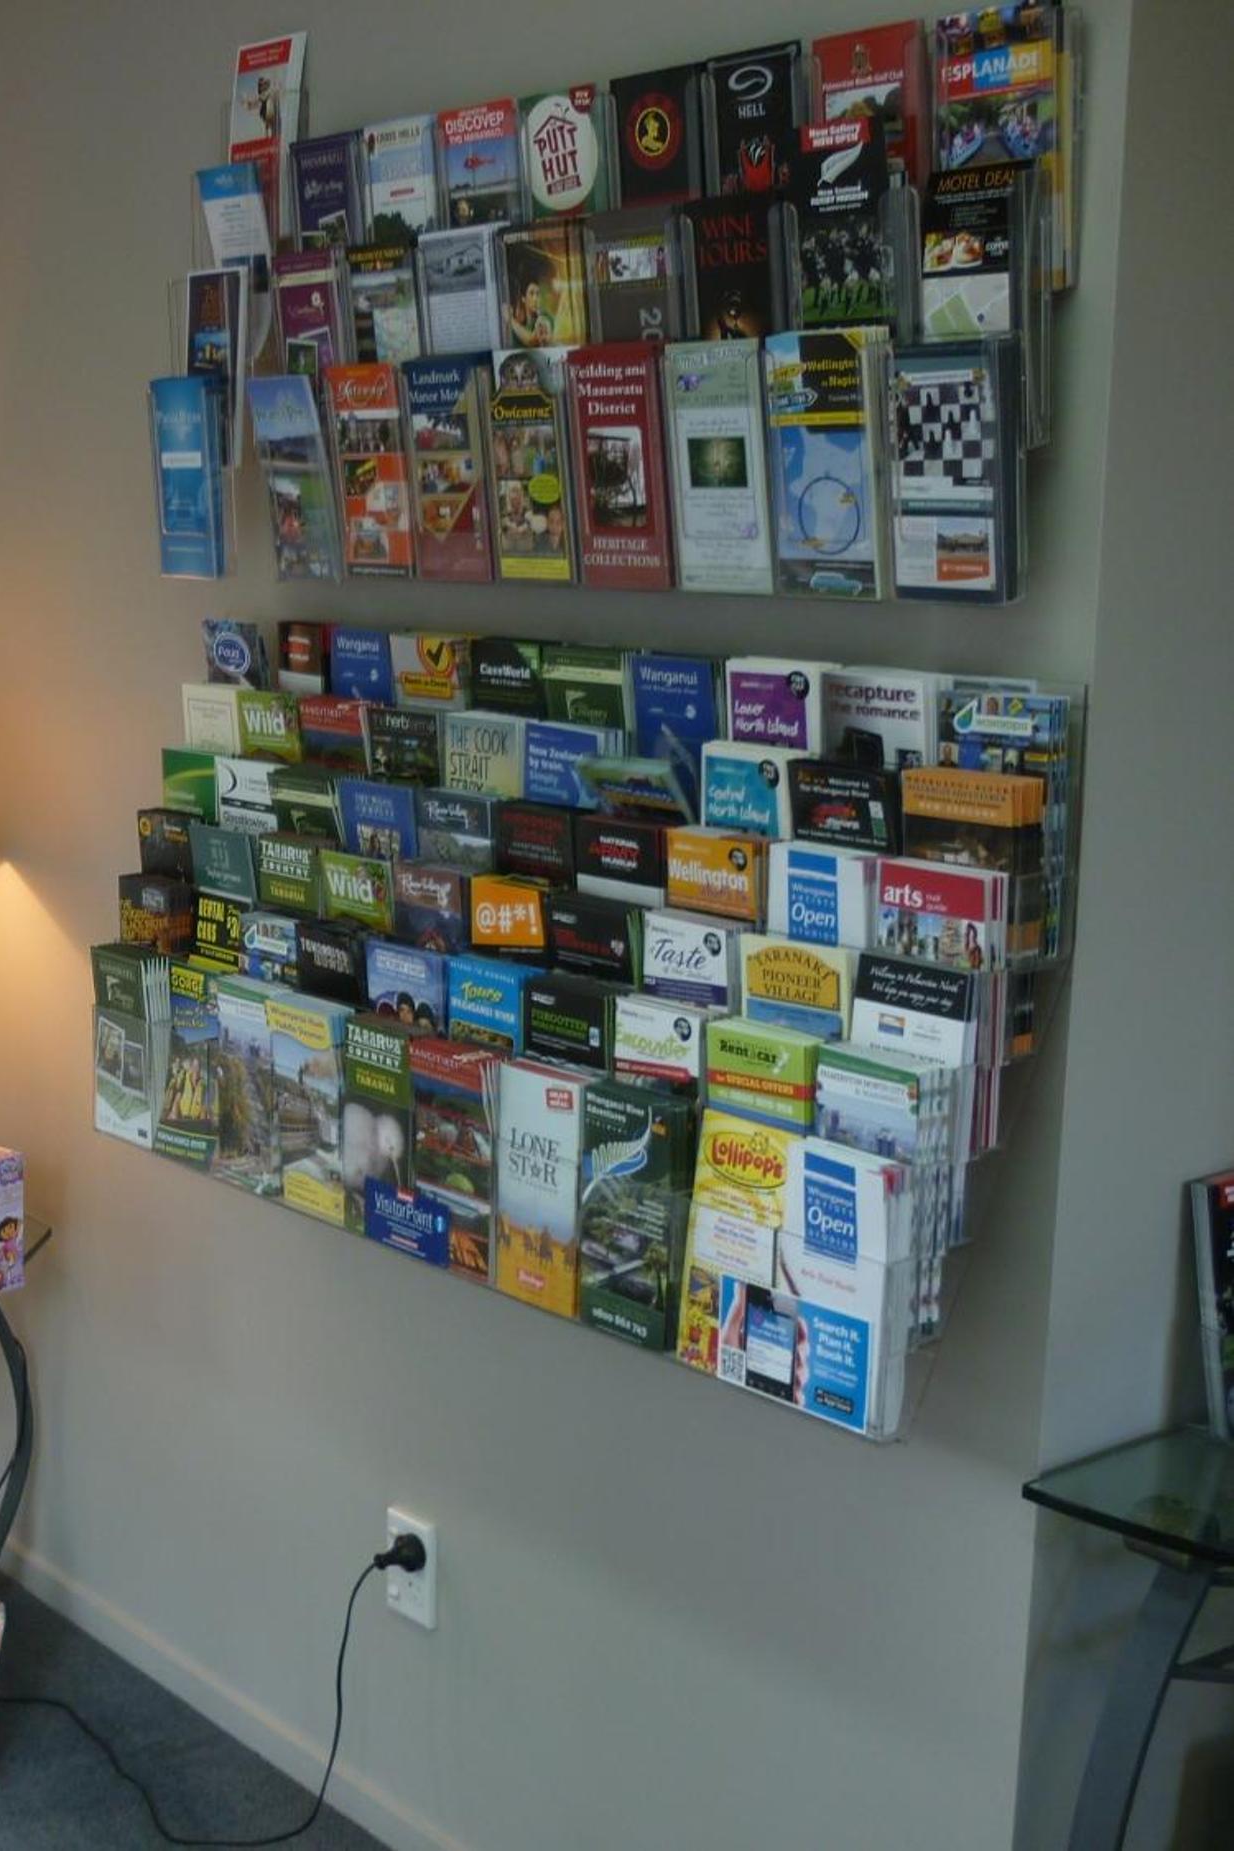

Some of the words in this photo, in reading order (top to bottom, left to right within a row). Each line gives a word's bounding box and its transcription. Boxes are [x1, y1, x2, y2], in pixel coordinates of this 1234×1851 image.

[445, 111, 505, 135] DISCOVER
[738, 103, 766, 119] HELL
[533, 124, 578, 158] PUTT
[541, 150, 579, 182] HUT
[937, 174, 978, 193] MOTEL
[412, 369, 461, 386] Landmark
[577, 383, 643, 397] Manawatu
[494, 404, 553, 420] Owlcatraz
[588, 402, 636, 417] District
[592, 536, 648, 552] HERITAGE
[243, 707, 286, 738] Wild
[386, 713, 409, 730] herb
[855, 705, 920, 722] romance
[733, 720, 764, 734] North
[451, 724, 469, 748] THE
[473, 728, 508, 756] COOK
[450, 752, 491, 782] STRAIT
[529, 759, 541, 773] by
[326, 864, 374, 905] Wild
[669, 857, 749, 893] Wellington
[883, 884, 923, 908] arts
[791, 902, 836, 928] Open
[653, 938, 707, 971] Taste
[762, 968, 822, 990] PIONEER
[764, 982, 818, 1003] VILLAGE
[347, 1023, 402, 1056] TARARUA
[347, 1045, 400, 1069] COUNTRY
[510, 1126, 561, 1164] LONE
[712, 1137, 783, 1180] Lollipop's
[374, 1192, 433, 1230] VisitorPoint
[807, 1205, 855, 1236] Open
